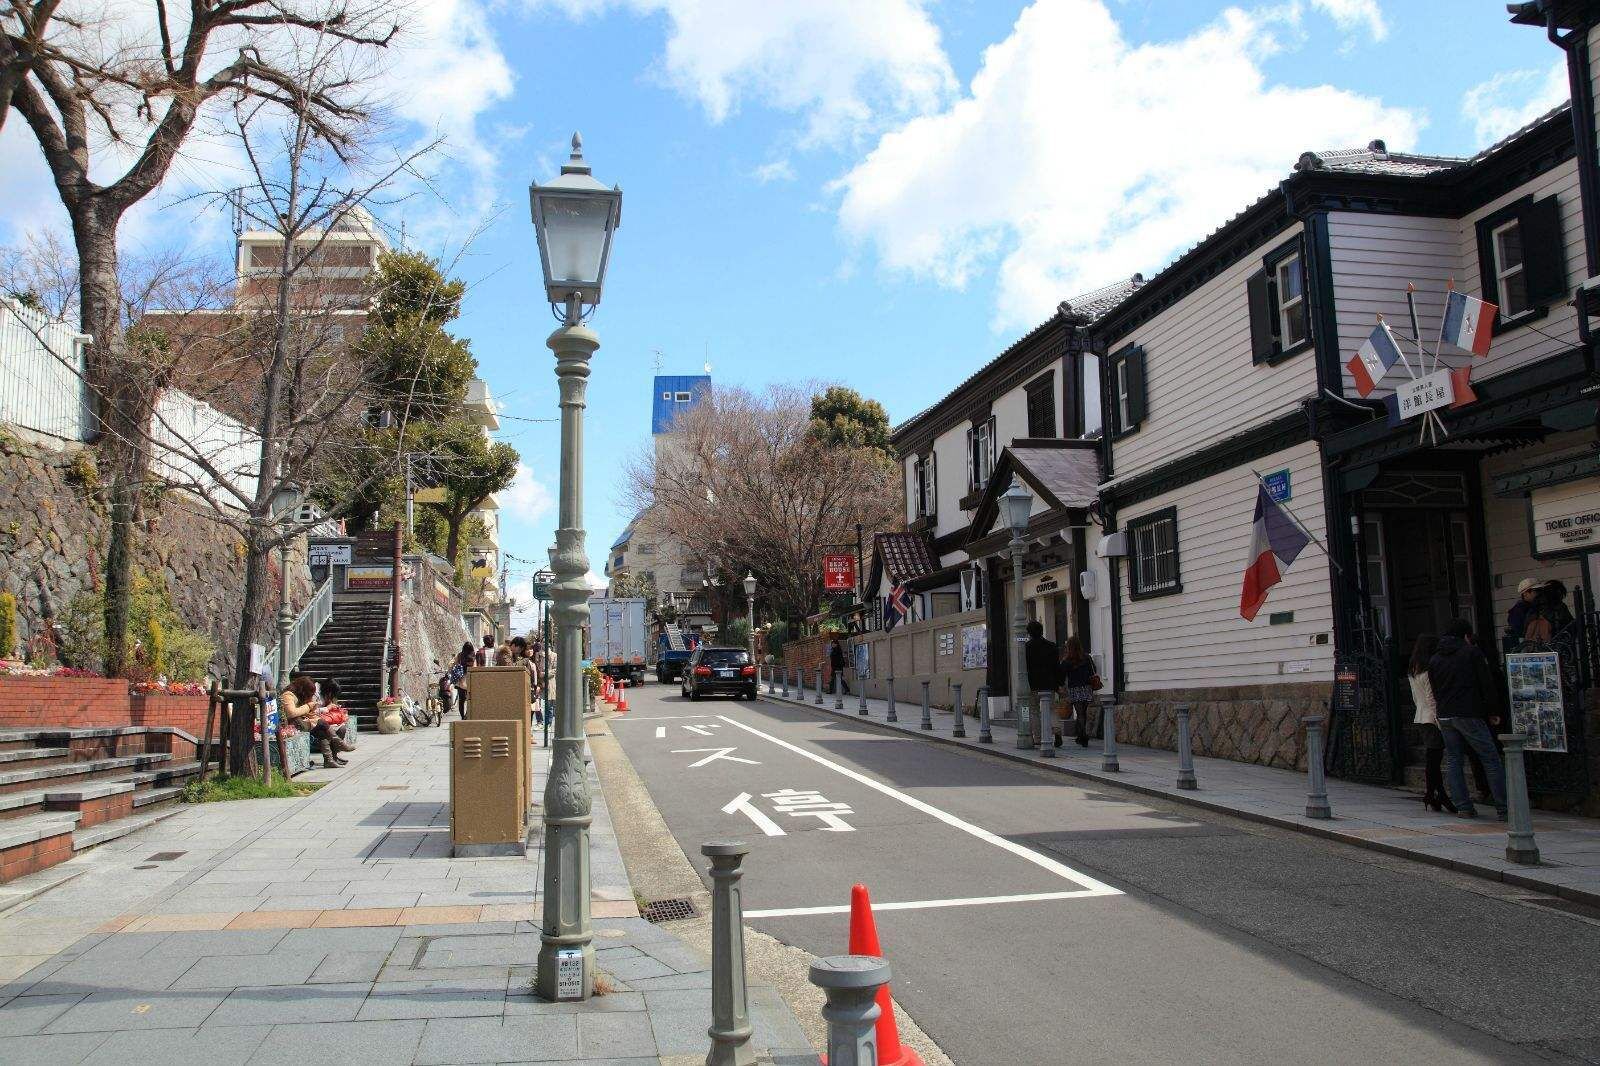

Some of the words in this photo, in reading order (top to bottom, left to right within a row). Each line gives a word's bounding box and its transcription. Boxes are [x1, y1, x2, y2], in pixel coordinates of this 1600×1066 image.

[1402, 386, 1445, 411] 洋館長屋
[1545, 518, 1571, 531] TICKET
[1560, 527, 1593, 539] RECEPTION
[656, 724, 857, 837] バス停
